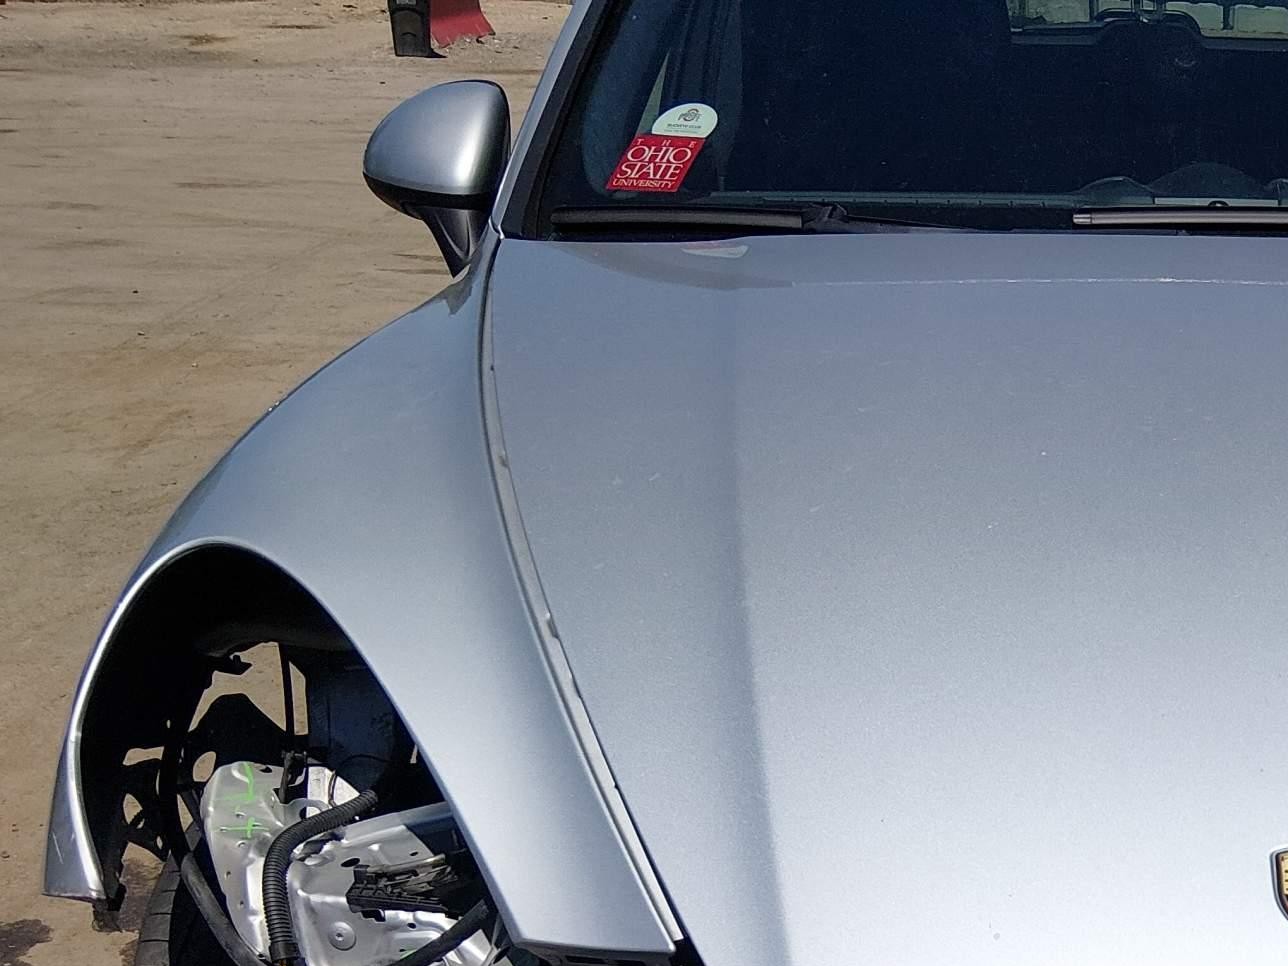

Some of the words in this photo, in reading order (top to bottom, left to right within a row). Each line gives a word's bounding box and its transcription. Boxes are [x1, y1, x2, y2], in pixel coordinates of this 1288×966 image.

[627, 145, 692, 163] OHIO
[617, 161, 683, 180] STATE
[612, 178, 675, 188] UNIVERSITY
